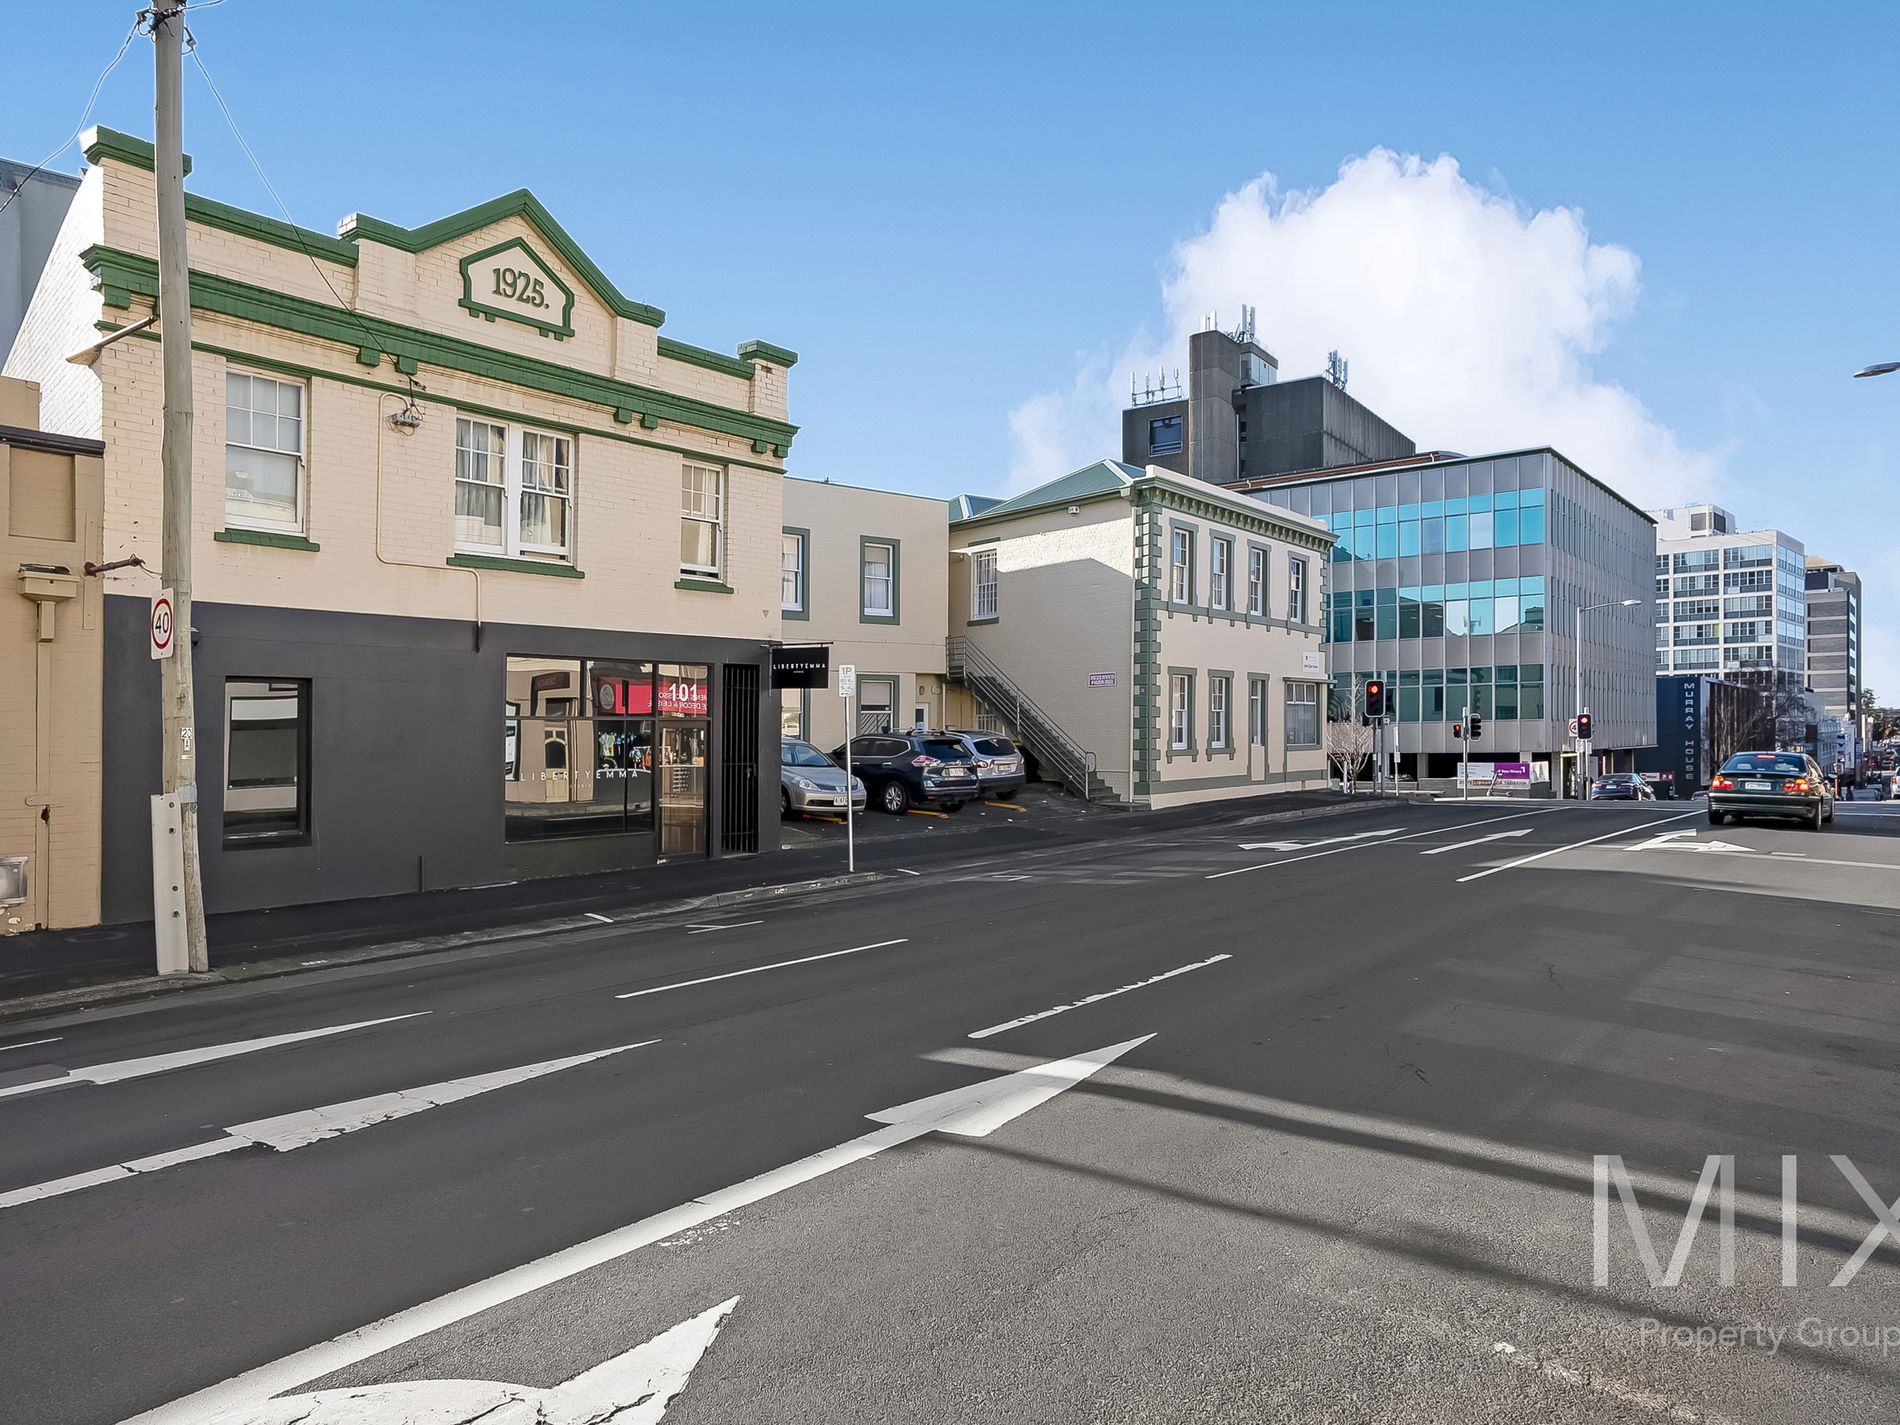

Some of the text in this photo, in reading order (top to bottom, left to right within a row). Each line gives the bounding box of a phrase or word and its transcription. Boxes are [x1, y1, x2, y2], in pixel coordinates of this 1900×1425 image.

[155, 612, 169, 634] 40
[842, 667, 852, 675] 1P
[669, 683, 697, 702] 101
[1684, 683, 1695, 730] MURRAY
[1685, 741, 1694, 780] HOUSE
